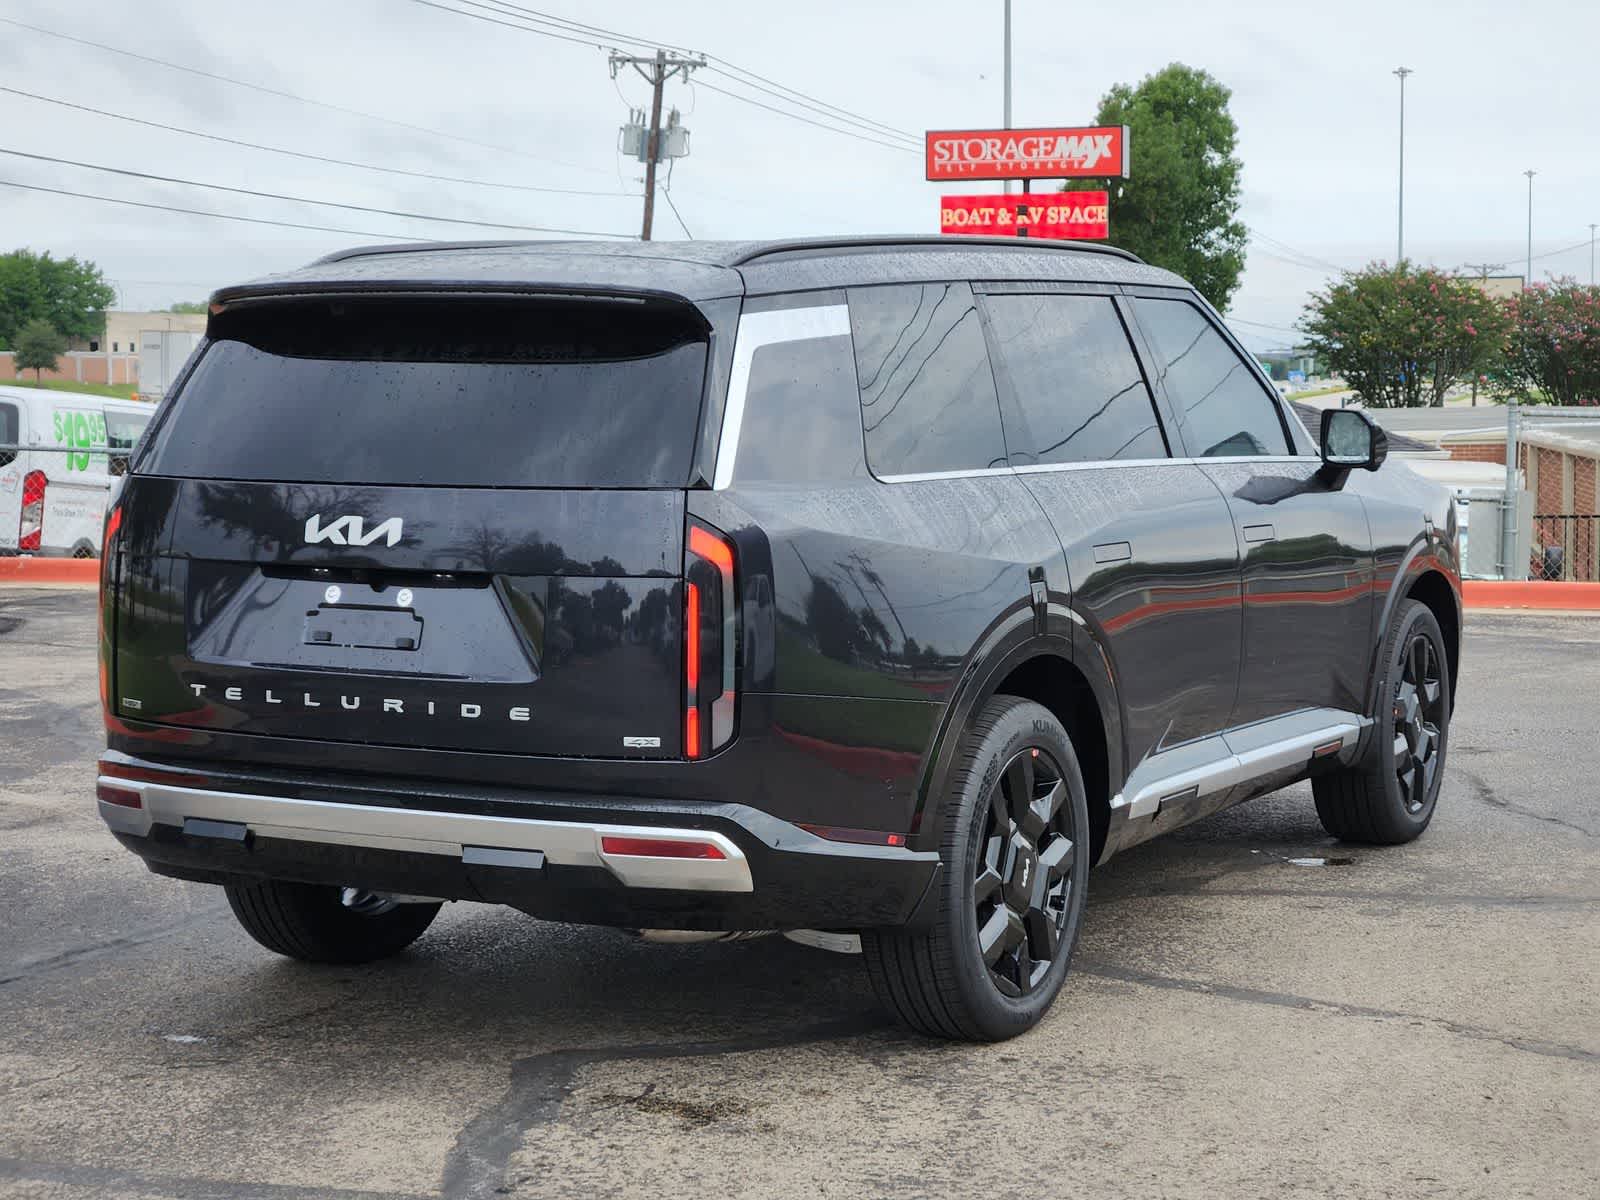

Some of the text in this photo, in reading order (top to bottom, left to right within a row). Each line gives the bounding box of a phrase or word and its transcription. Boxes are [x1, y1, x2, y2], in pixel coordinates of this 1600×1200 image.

[942, 208, 995, 226] BOAT
[996, 207, 1012, 226] &
[304, 513, 404, 548] KIA
[190, 683, 531, 722] TELLURIDE
